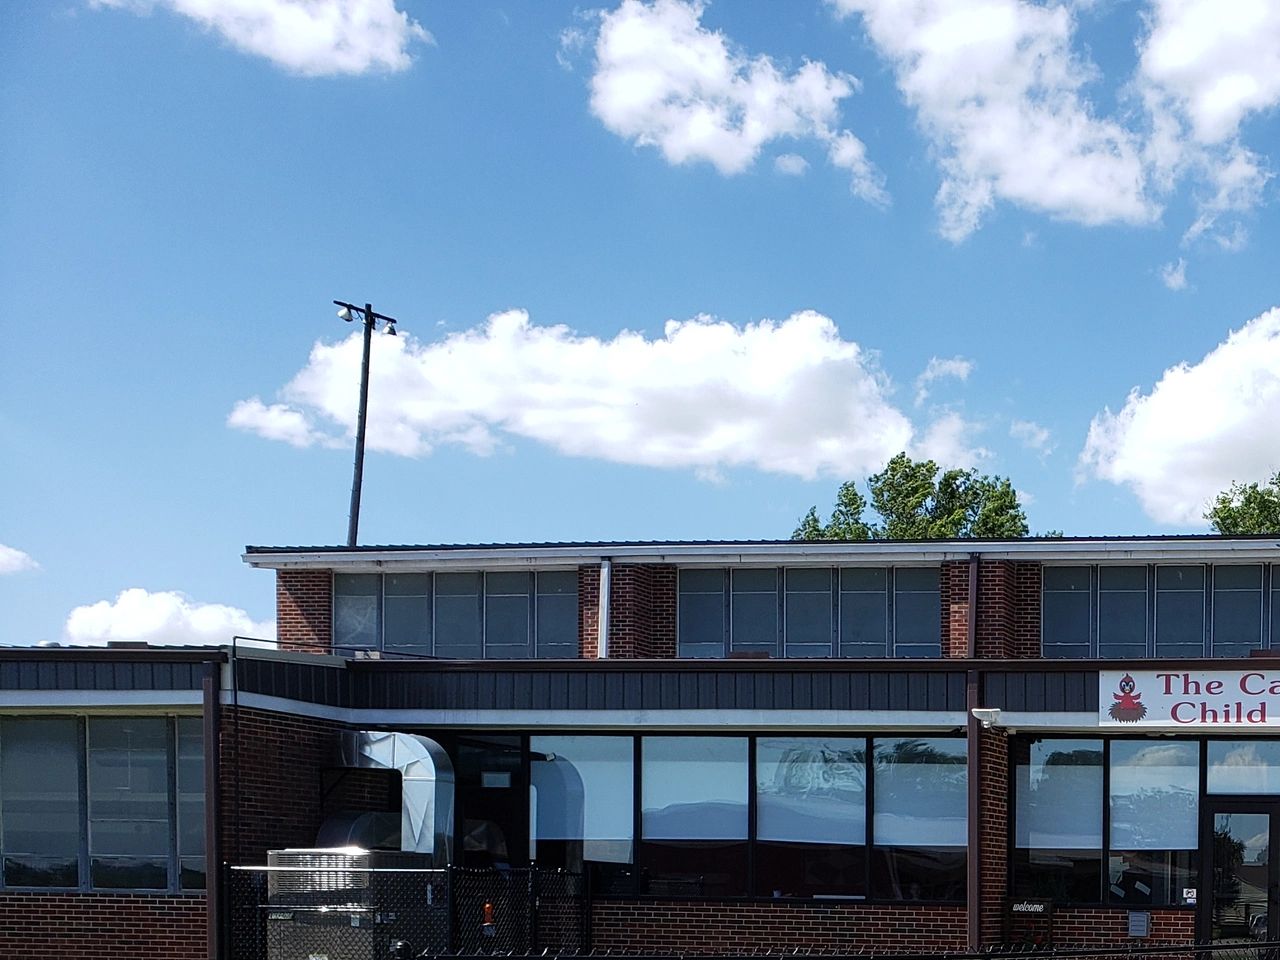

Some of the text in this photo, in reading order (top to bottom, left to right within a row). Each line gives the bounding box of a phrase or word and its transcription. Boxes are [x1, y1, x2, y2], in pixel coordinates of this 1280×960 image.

[1156, 673, 1224, 695] The
[1170, 702, 1267, 724] Child
[1013, 901, 1044, 912] welcome
